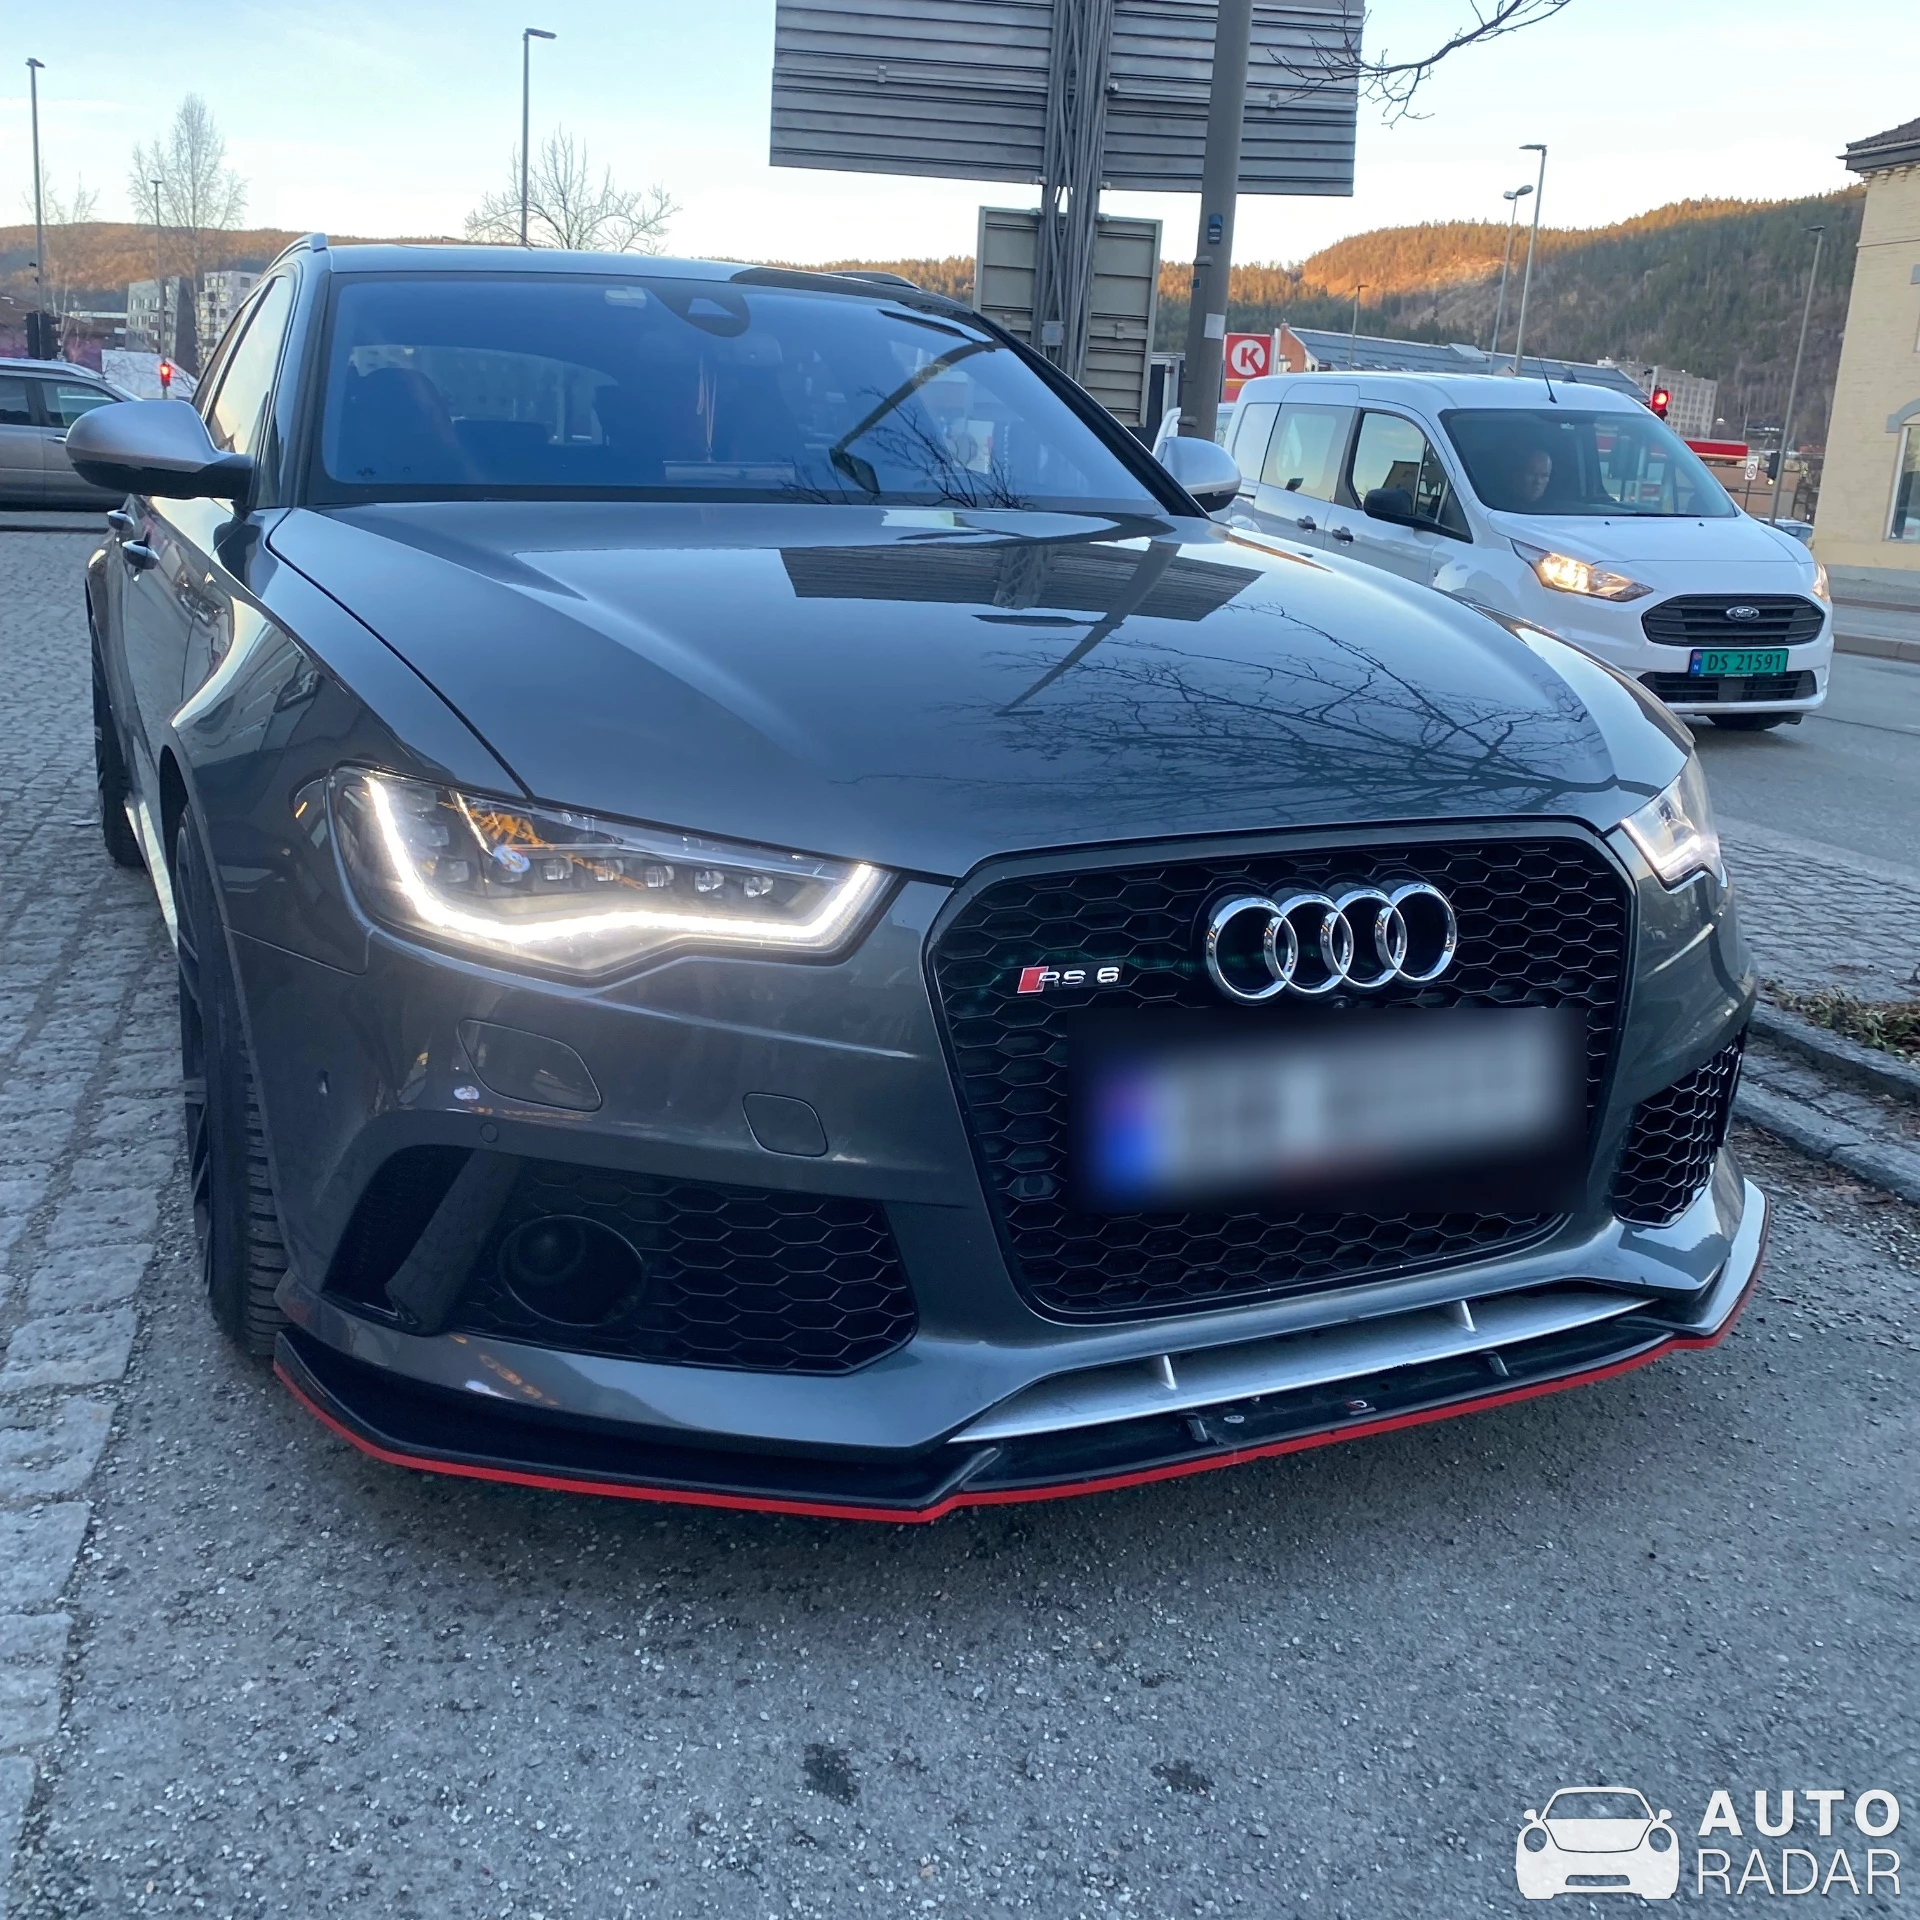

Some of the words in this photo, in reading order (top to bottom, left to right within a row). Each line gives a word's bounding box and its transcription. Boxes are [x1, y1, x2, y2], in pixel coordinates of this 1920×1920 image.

[1240, 346, 1262, 376] K
[1707, 653, 1729, 672] DS
[1735, 653, 1782, 671] 21591
[1036, 969, 1087, 989] RS
[1096, 966, 1120, 984] 6
